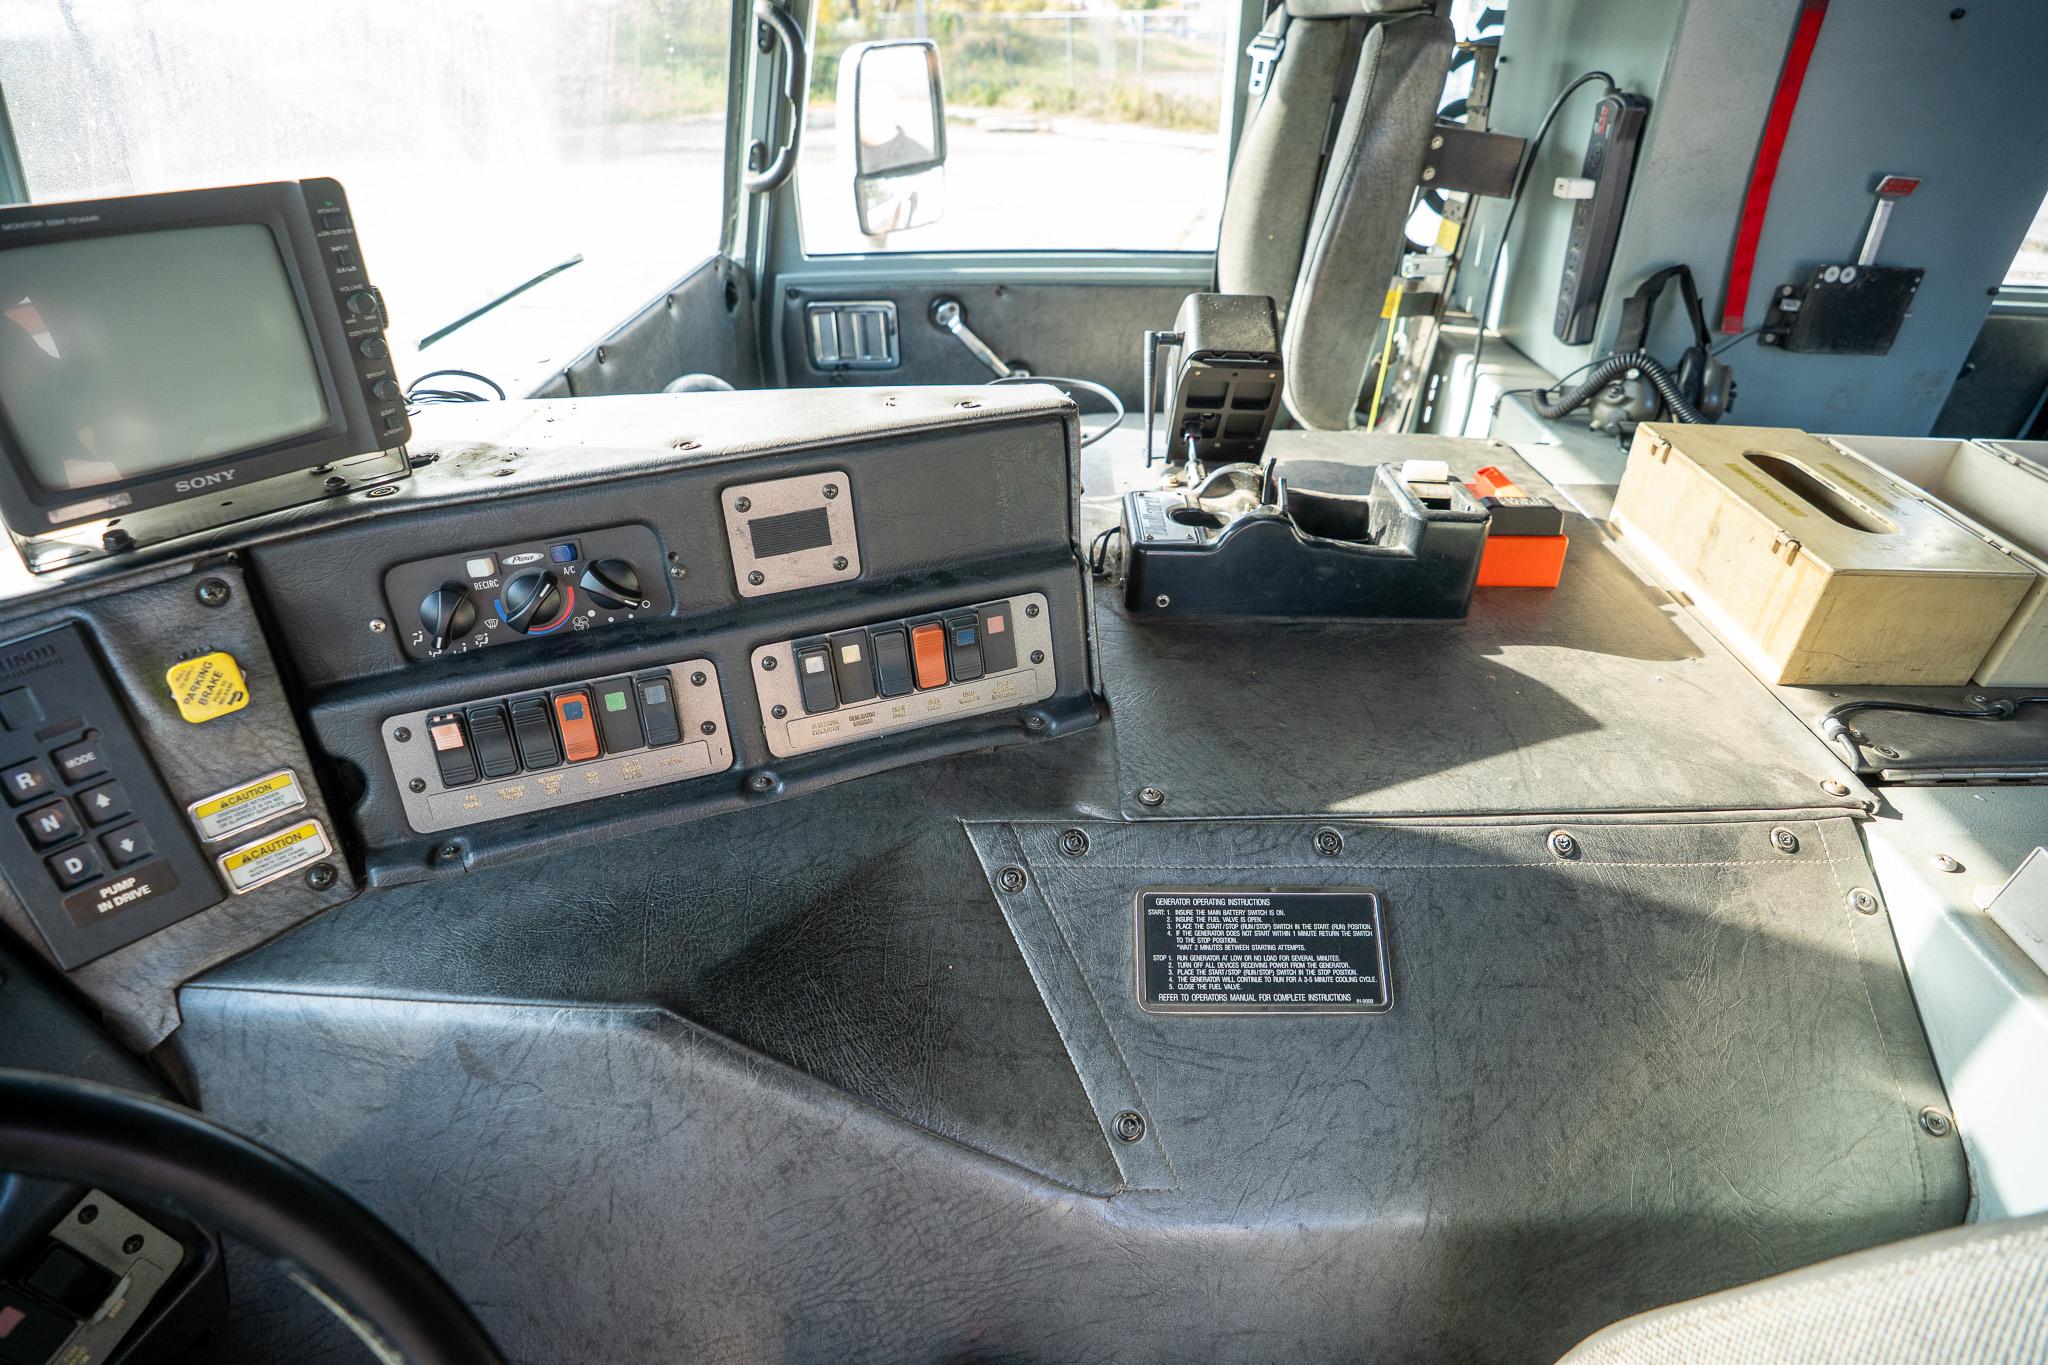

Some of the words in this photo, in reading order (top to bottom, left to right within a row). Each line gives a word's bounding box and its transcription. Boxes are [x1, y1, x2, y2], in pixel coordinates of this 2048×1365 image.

[174, 469, 236, 492] SONY
[563, 566, 576, 576] A/C
[474, 579, 500, 591] RECIRC
[184, 661, 214, 704] PARKING
[198, 671, 224, 706] BRAKE
[64, 752, 96, 769] MODE
[16, 772, 36, 790] R
[226, 784, 273, 806] CAUTION
[40, 814, 60, 832] N
[250, 832, 302, 858] CAUTION
[64, 858, 84, 874] D
[96, 900, 114, 914] IN
[112, 884, 152, 907] DRIVE
[99, 877, 136, 899] PUMP
